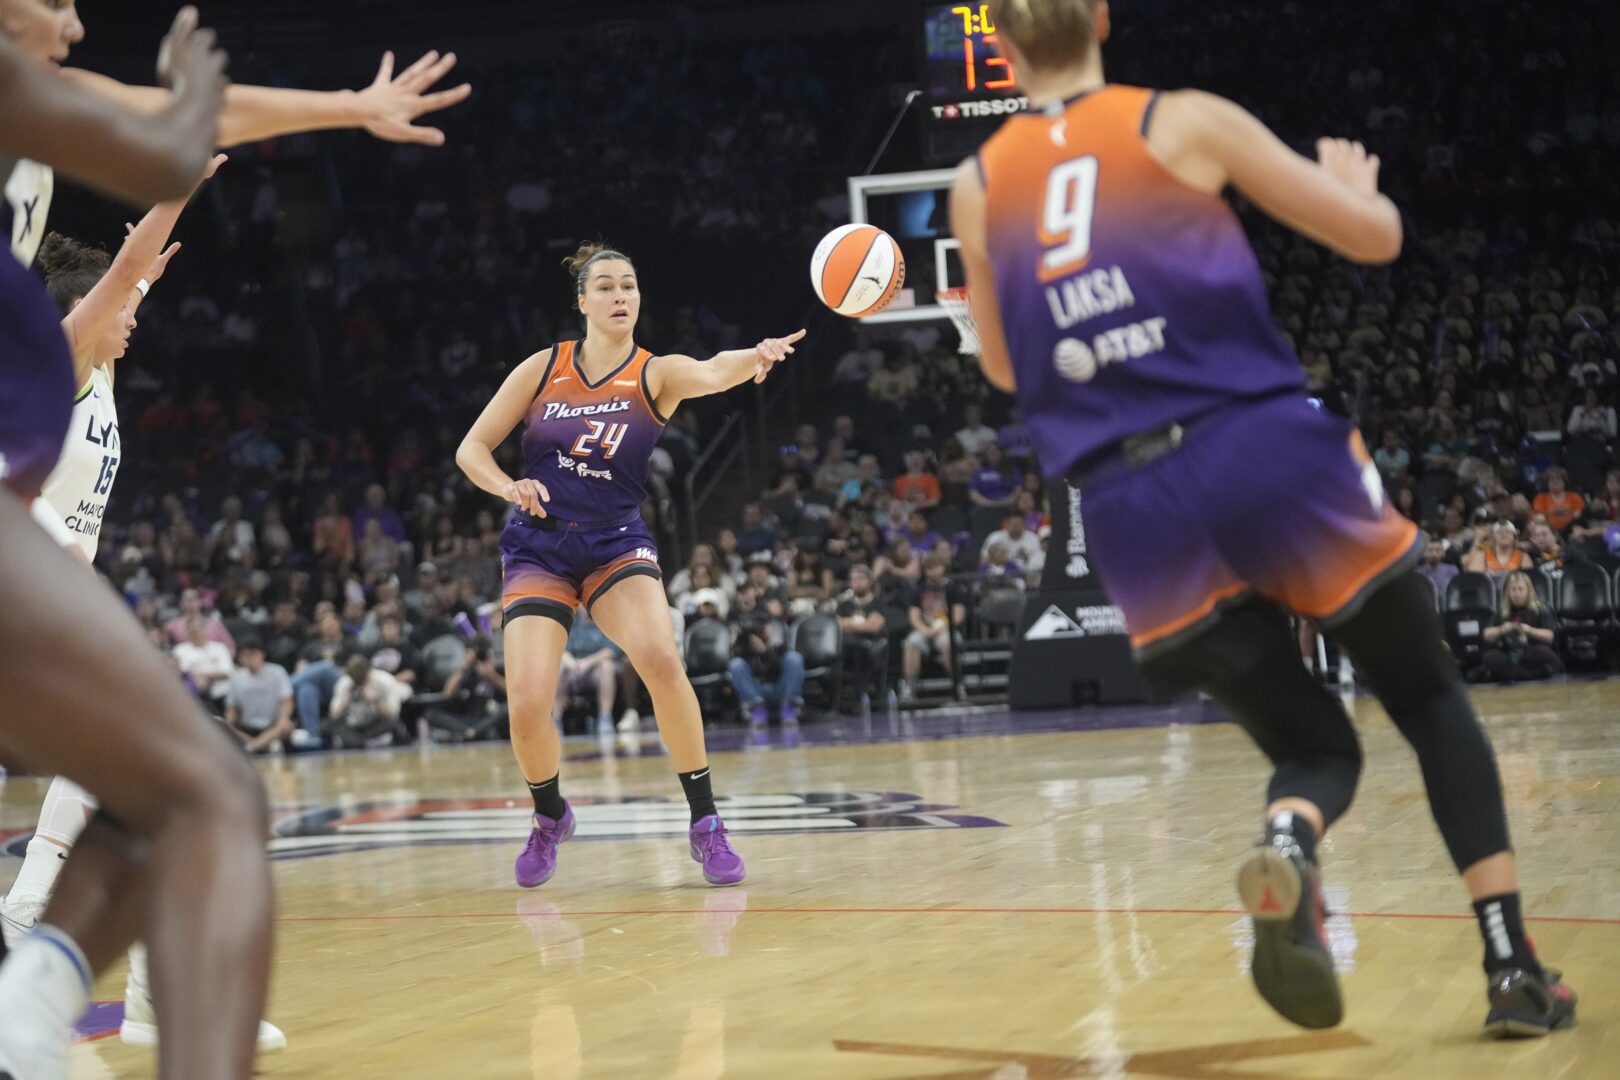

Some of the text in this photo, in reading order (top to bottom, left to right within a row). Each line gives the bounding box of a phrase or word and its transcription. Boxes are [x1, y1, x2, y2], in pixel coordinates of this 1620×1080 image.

[1037, 153, 1098, 283] 9
[1045, 264, 1136, 330] LAKSA
[542, 395, 632, 421] Phoenix
[569, 418, 629, 460] 24
[93, 455, 118, 496] 15
[76, 499, 105, 519] MAYO
